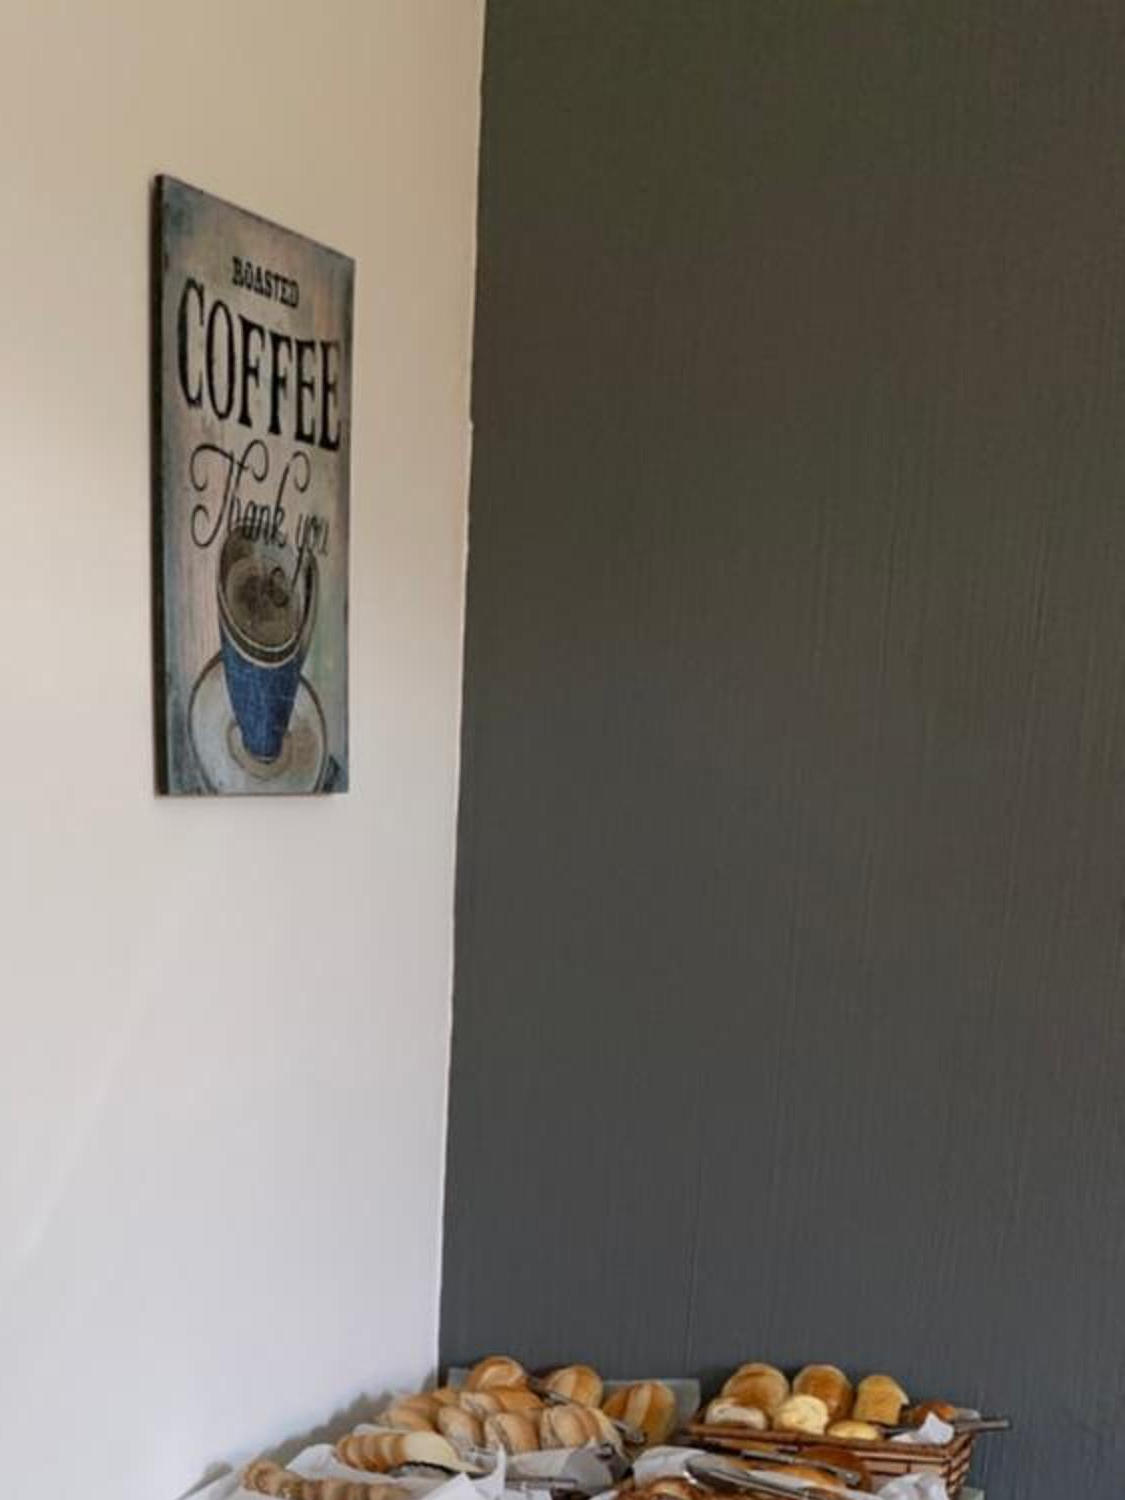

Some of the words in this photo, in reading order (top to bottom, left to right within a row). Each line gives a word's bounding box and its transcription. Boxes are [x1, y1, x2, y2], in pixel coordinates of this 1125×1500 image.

[231, 255, 300, 309] ROASTED
[177, 276, 342, 452] COFFEE
[190, 439, 311, 549] Thank
